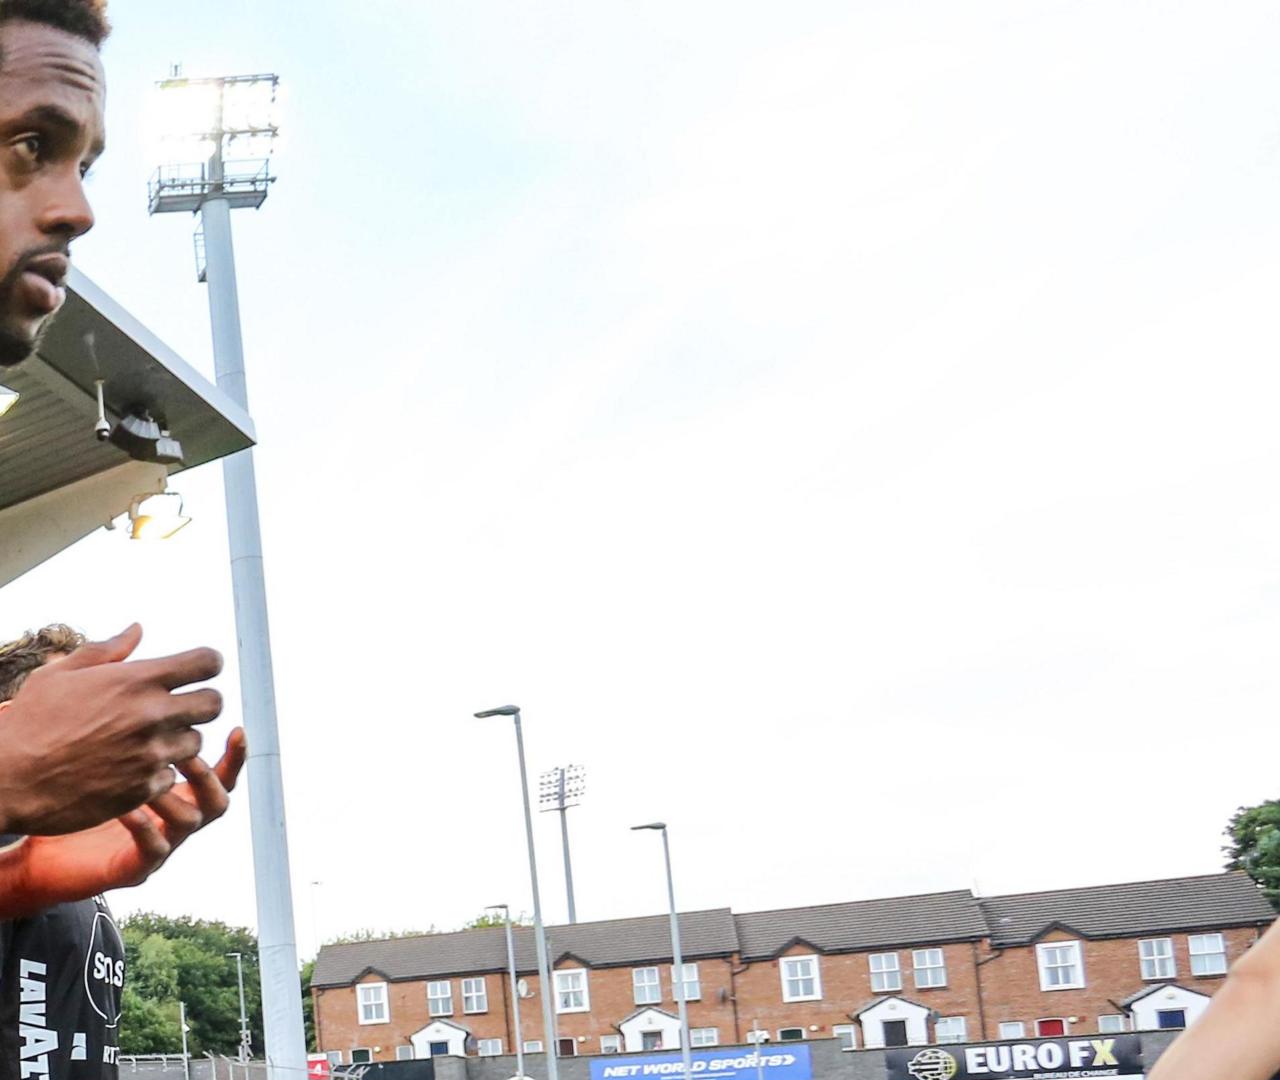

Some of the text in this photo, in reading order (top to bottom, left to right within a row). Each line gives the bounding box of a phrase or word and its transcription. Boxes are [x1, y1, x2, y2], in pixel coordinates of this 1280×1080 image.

[603, 1065, 642, 1077] NET
[708, 1054, 784, 1071] SPORTS
[964, 1039, 1119, 1074] EURO FX
[1068, 1070, 1081, 1078] DE
